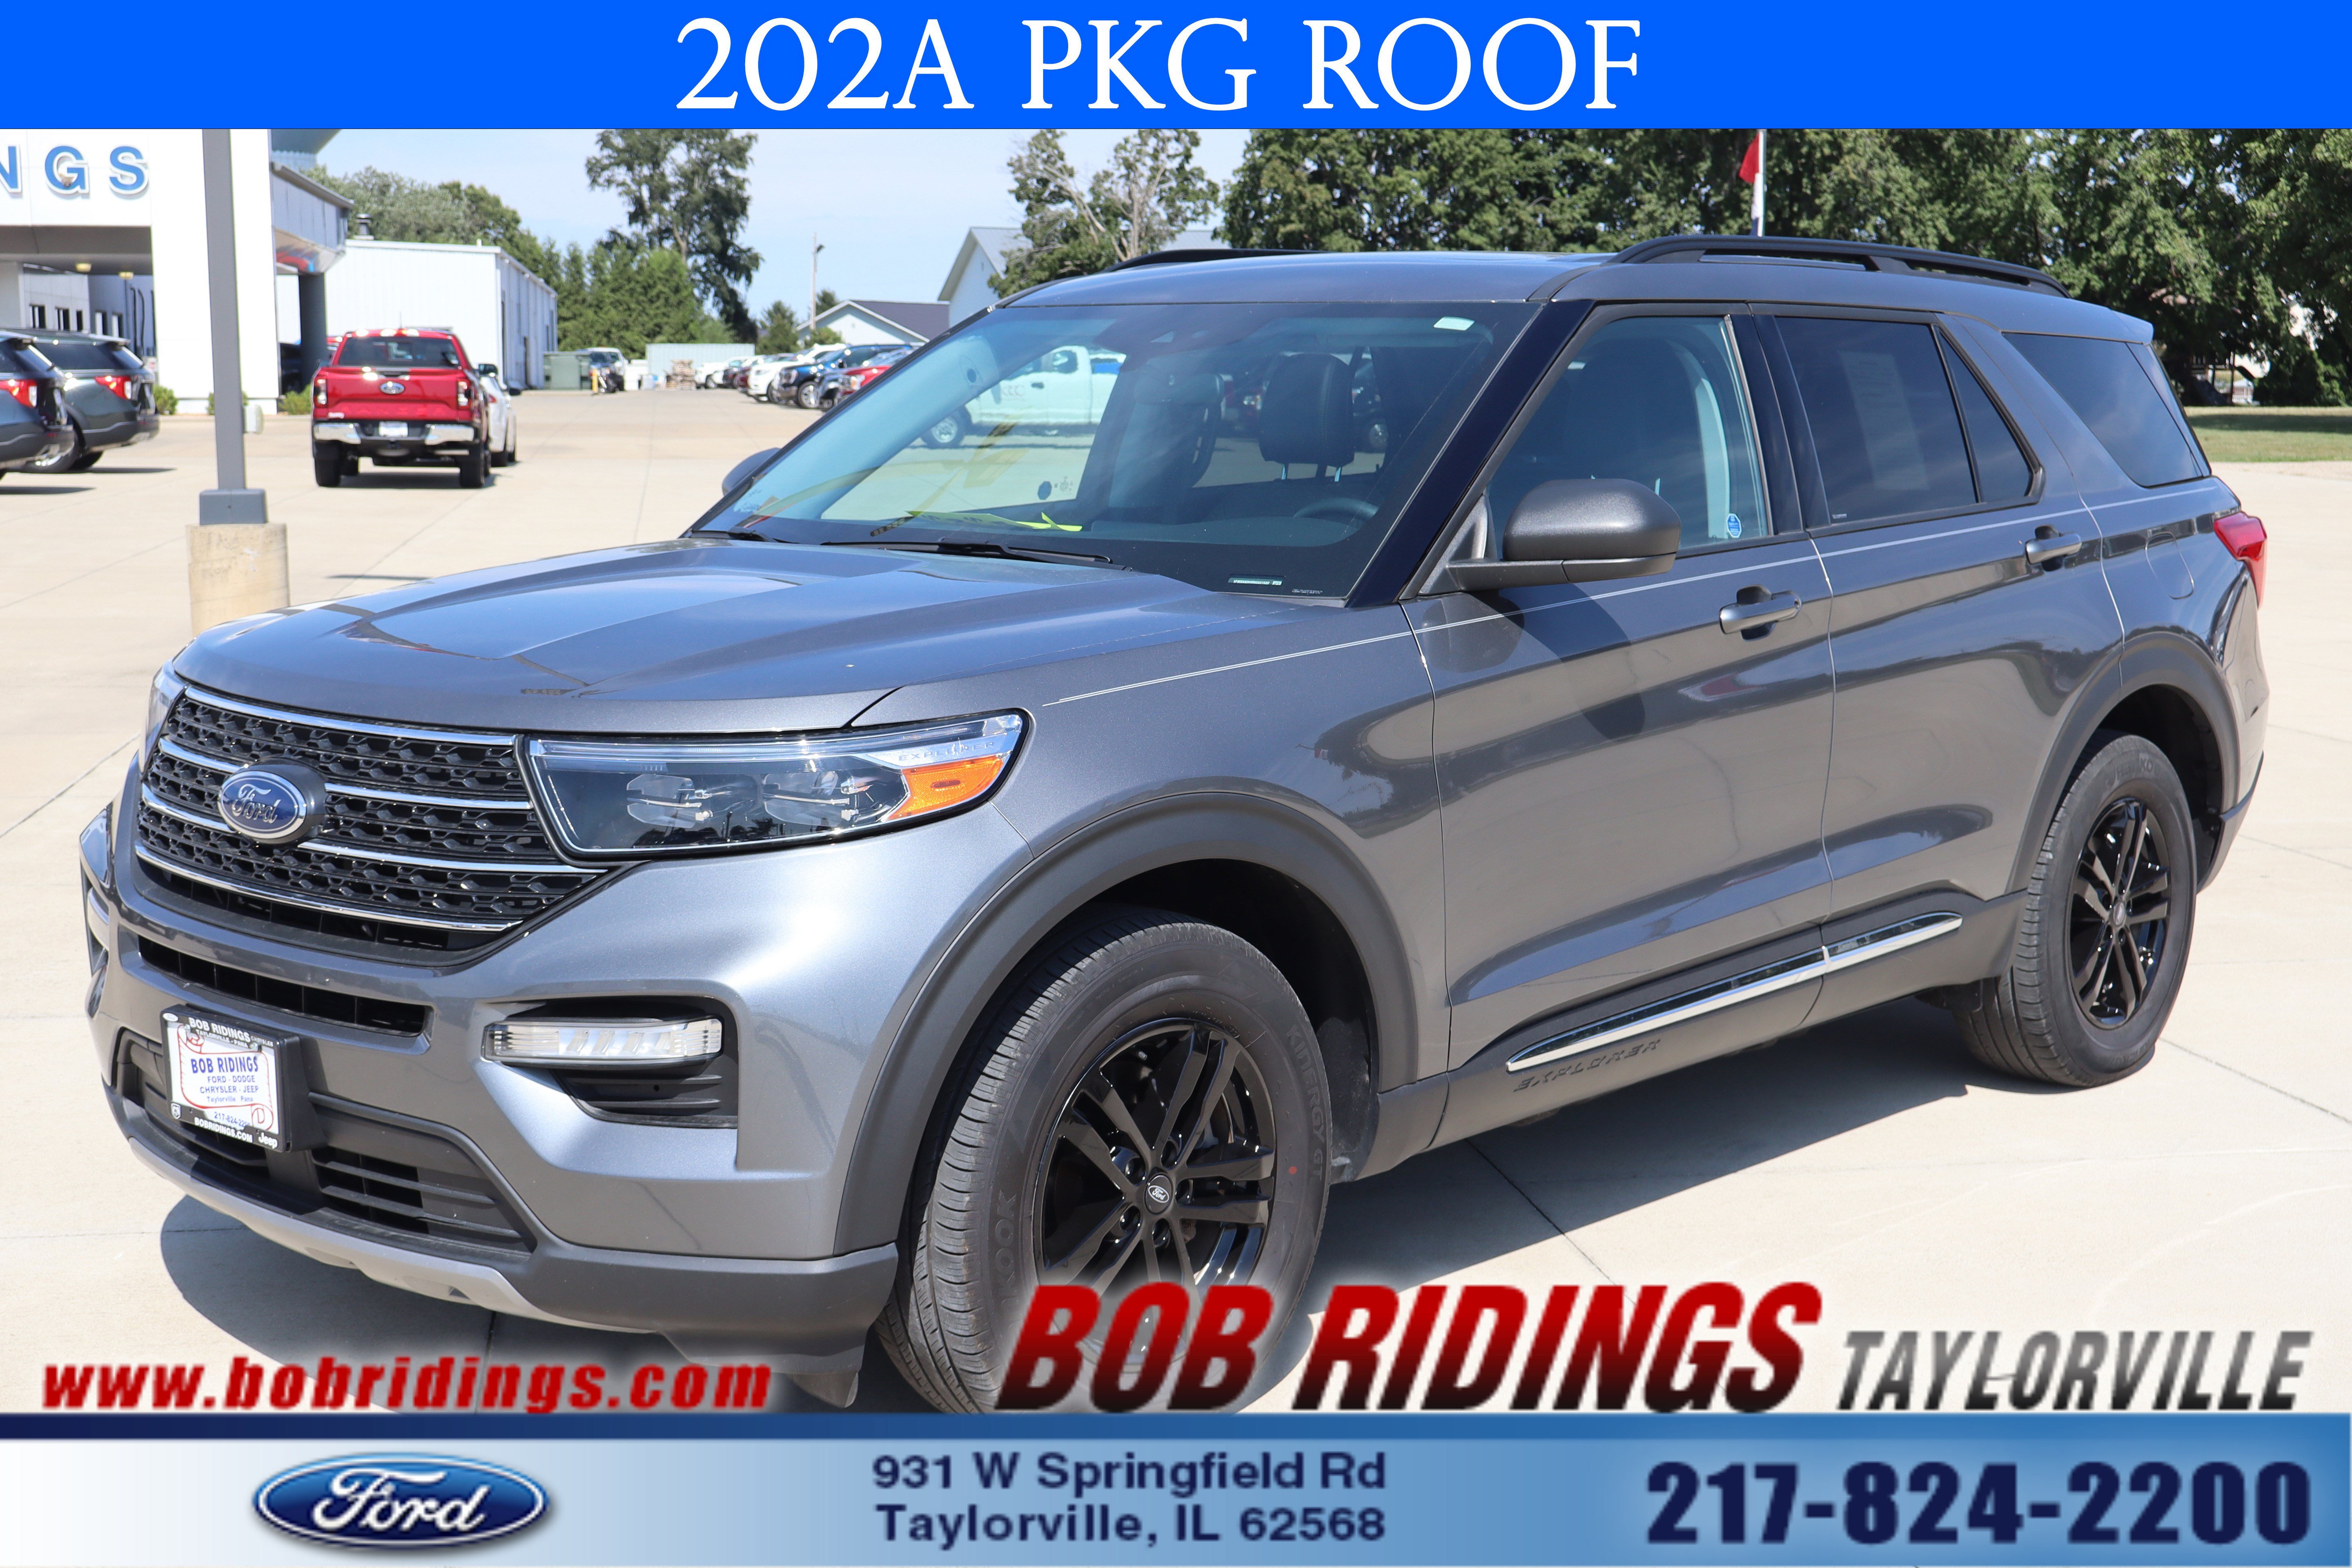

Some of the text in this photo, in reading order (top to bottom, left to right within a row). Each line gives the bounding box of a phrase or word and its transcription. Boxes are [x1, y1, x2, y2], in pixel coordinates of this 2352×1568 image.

[232, 783, 281, 824] Ford
[189, 1017, 210, 1031] BOB
[211, 1023, 251, 1042] RIDINGS
[191, 1056, 258, 1074] BOB RIDINGS
[194, 1117, 253, 1143] BOBRIDINGS.COM
[258, 1132, 278, 1149] Jeep
[1152, 1187, 1166, 1200] Ford
